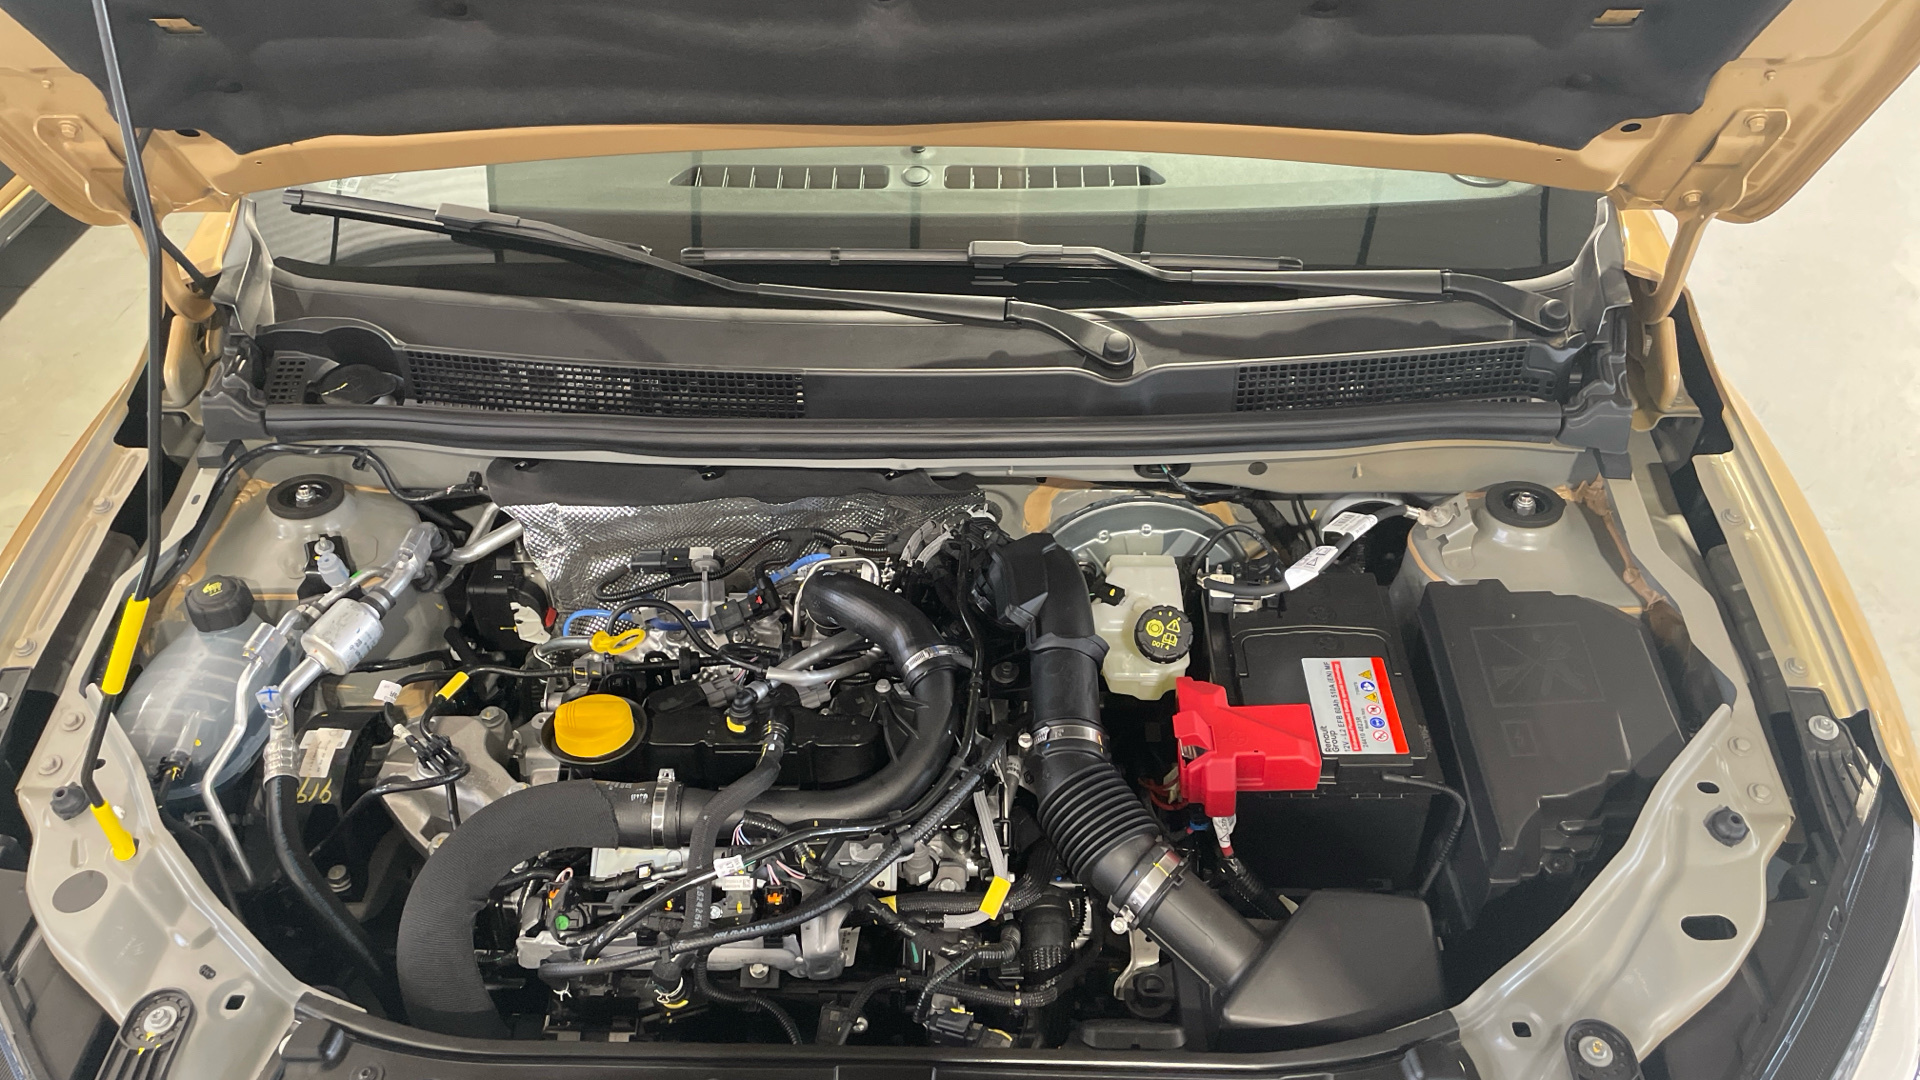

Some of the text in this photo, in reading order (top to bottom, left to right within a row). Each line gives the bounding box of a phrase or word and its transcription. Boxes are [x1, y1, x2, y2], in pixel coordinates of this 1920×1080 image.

[1151, 640, 1164, 648] DOT
[1336, 715, 1345, 727] EFB
[1320, 725, 1332, 752] Renault
[1340, 729, 1348, 737] L2
[1329, 730, 1340, 752] Group
[1343, 740, 1351, 752] 12V
